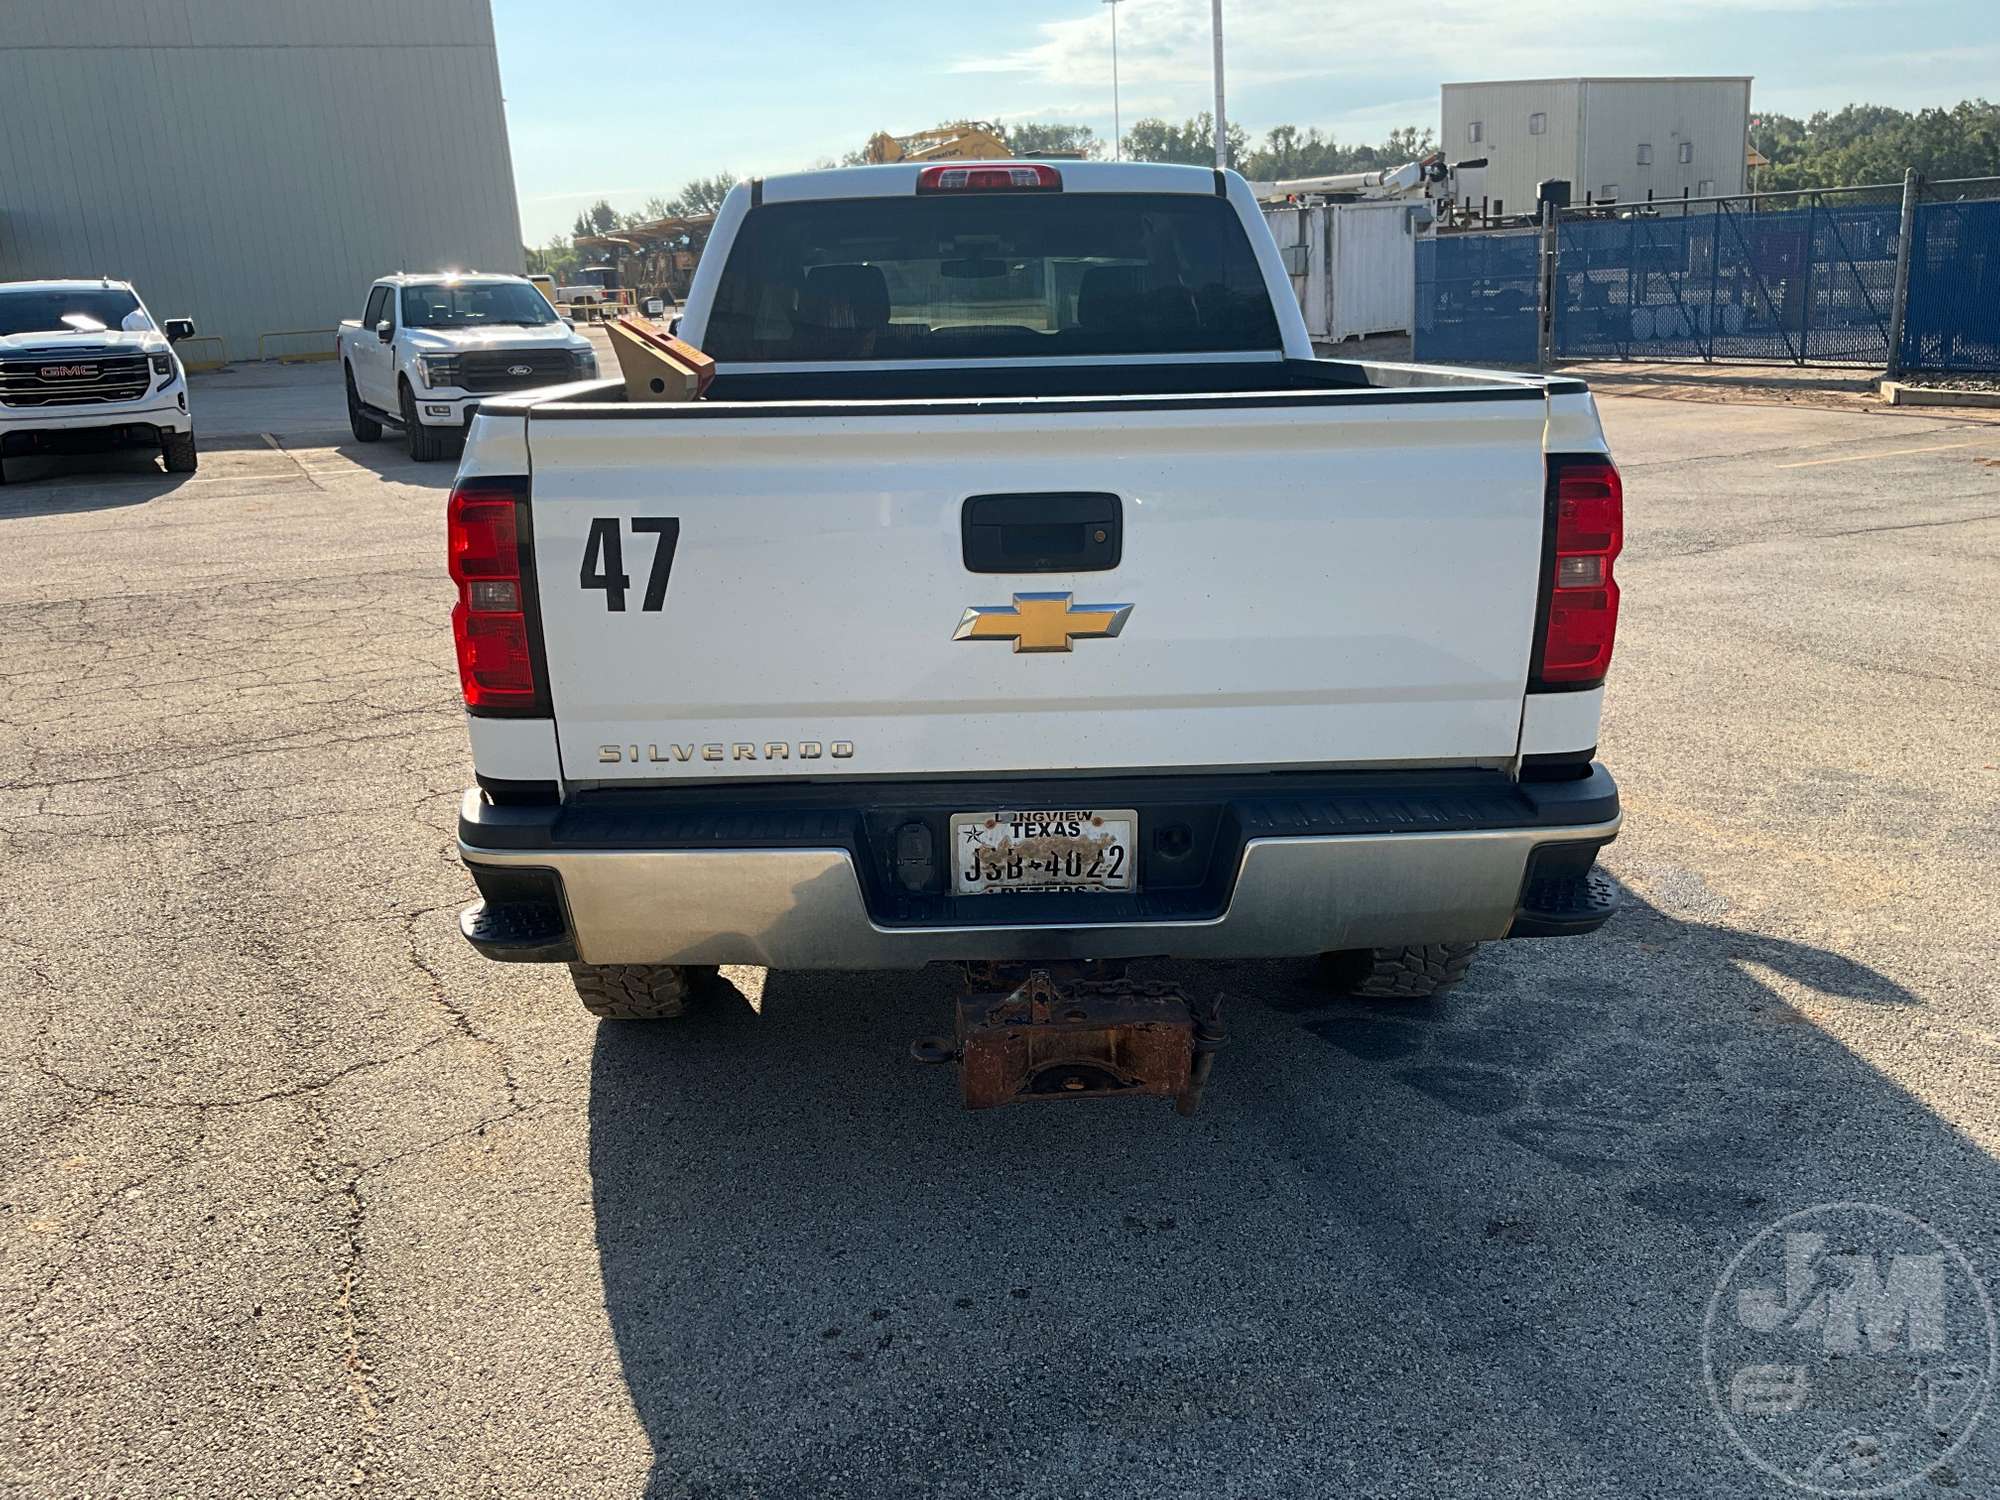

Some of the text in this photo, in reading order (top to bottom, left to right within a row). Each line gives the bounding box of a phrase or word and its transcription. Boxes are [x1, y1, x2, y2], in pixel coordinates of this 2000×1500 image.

[41, 365, 99, 377] GMC
[580, 517, 680, 612] 47
[598, 740, 854, 763] SILVERADO
[1010, 821, 1081, 839] TEXAS
